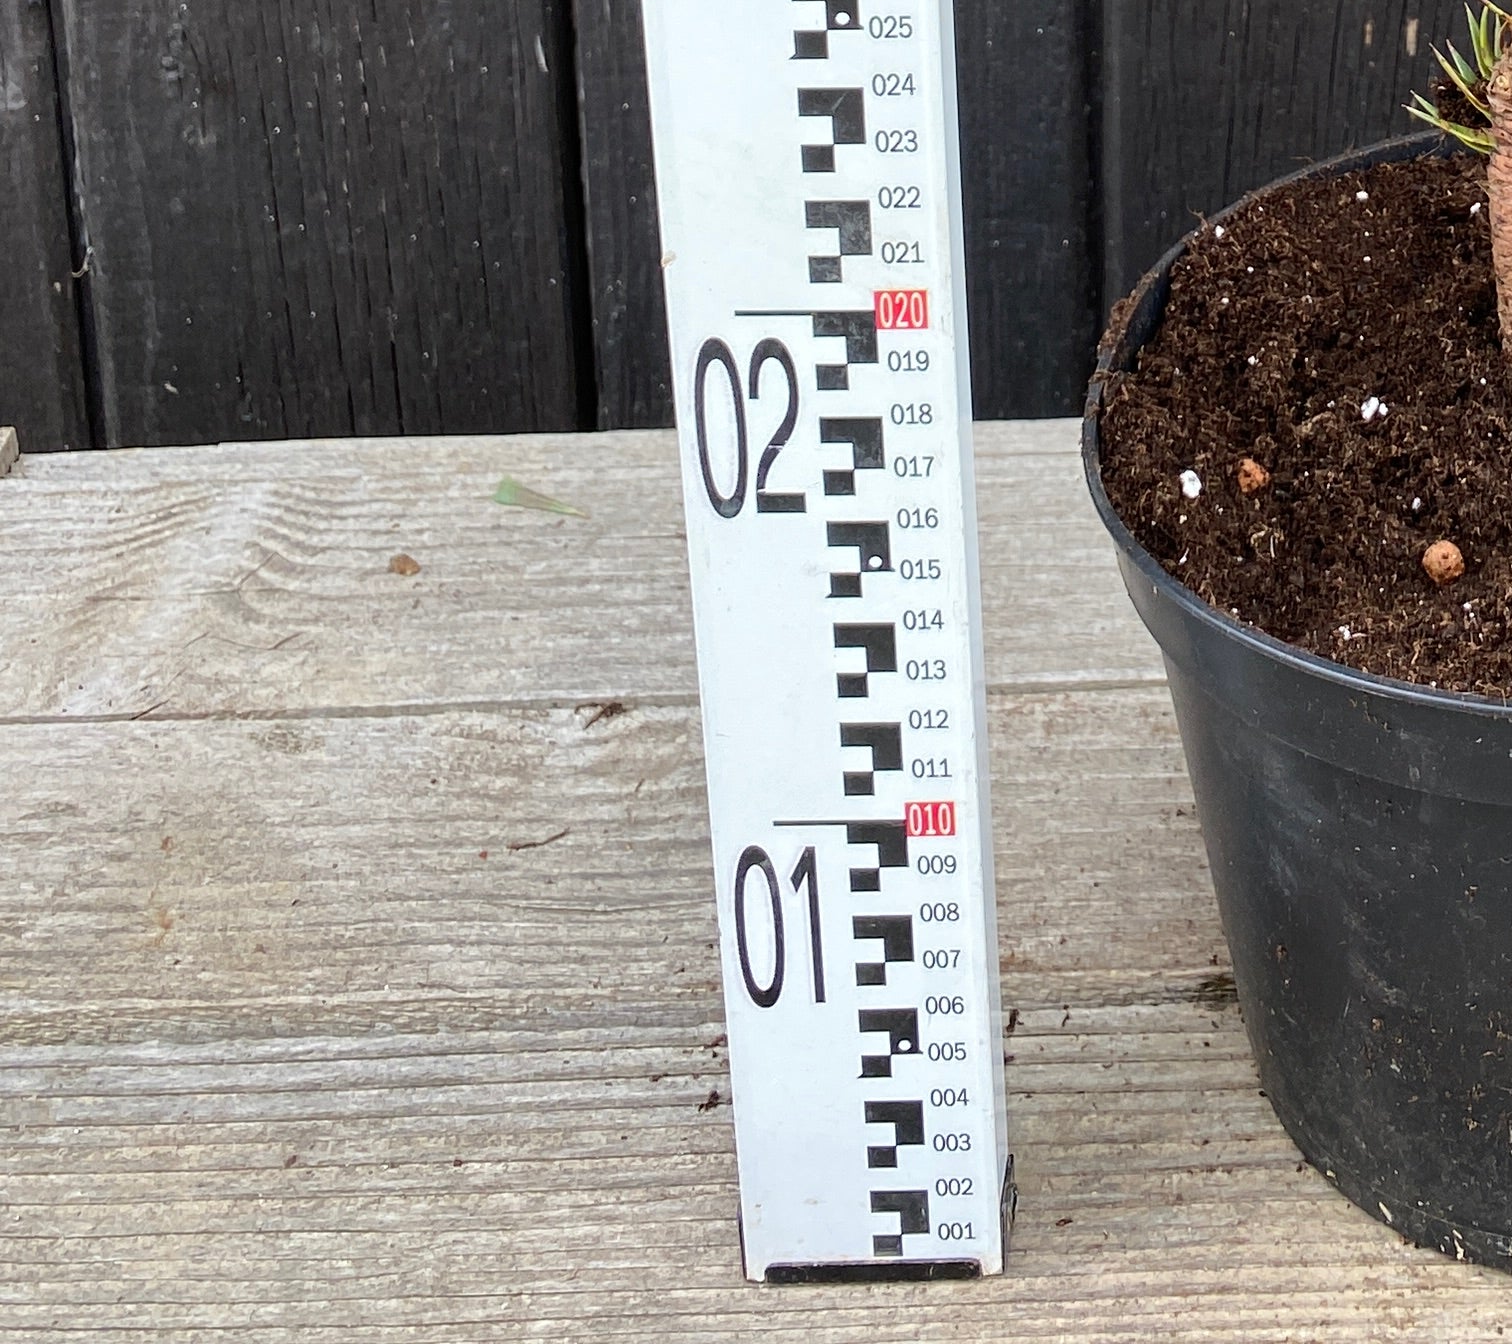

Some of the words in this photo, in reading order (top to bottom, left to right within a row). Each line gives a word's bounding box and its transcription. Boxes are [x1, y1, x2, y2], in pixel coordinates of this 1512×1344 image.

[868, 15, 913, 40] 025
[871, 73, 917, 97] 024
[875, 129, 918, 153] 023
[877, 186, 921, 209] 022
[881, 241, 925, 264] 021
[878, 291, 925, 329] 020
[887, 350, 930, 372] 019
[890, 403, 933, 426] 018
[695, 337, 806, 518] 02
[893, 455, 935, 478] 017
[896, 507, 939, 529] 016
[899, 558, 941, 580] 015
[902, 609, 945, 631] 014
[905, 659, 947, 681] 013
[908, 709, 949, 730] 012
[911, 758, 953, 779] 011
[908, 803, 952, 836] 010
[917, 854, 957, 875] 009
[919, 902, 960, 923] 008
[734, 844, 826, 1008] 01
[922, 949, 961, 970] 007
[925, 995, 965, 1015] 006
[927, 1041, 967, 1062] 005
[930, 1087, 970, 1108] 004
[932, 1133, 972, 1152] 003
[935, 1177, 974, 1197] 002
[937, 1221, 976, 1241] 001
